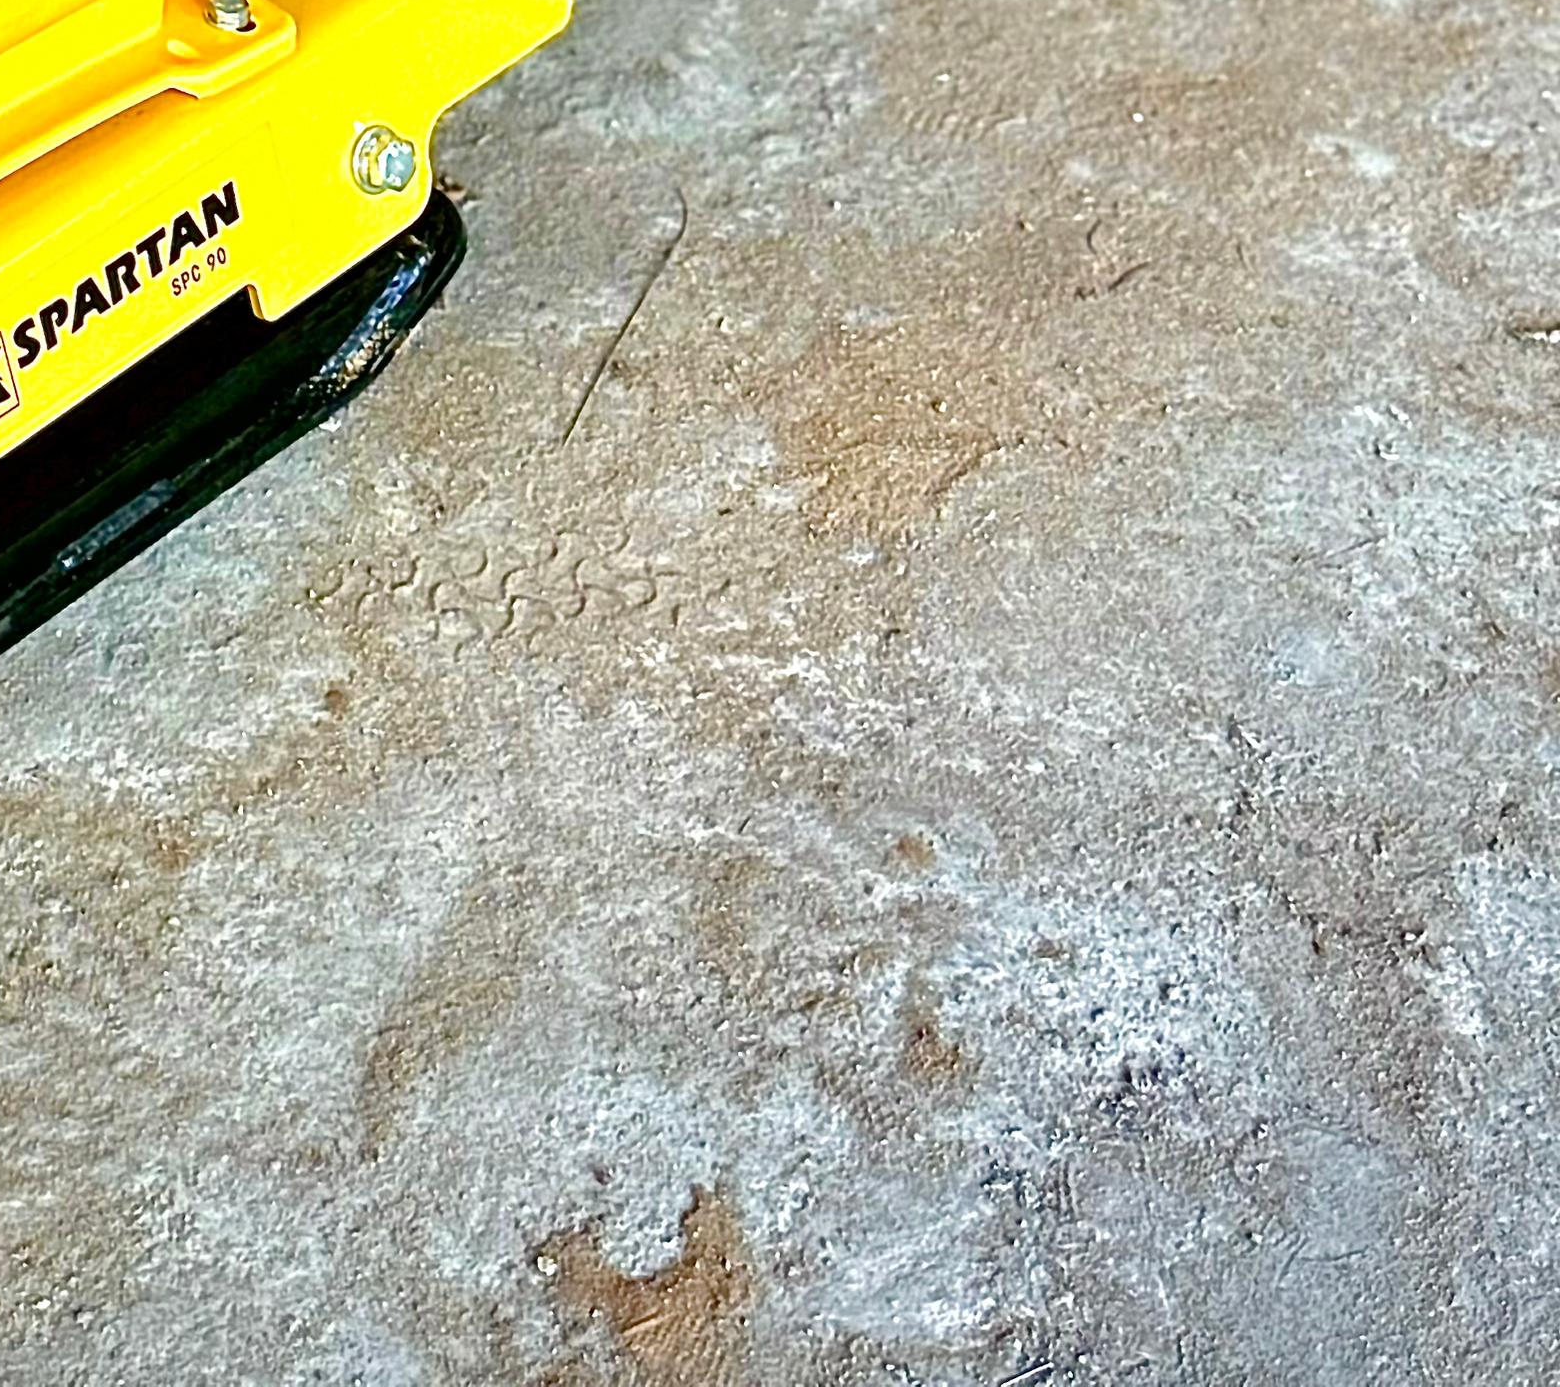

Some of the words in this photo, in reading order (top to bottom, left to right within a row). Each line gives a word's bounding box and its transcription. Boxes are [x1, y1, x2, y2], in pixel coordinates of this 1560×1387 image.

[13, 181, 240, 369] SPARTAN
[171, 263, 202, 297] SPC
[206, 246, 228, 273] 90
